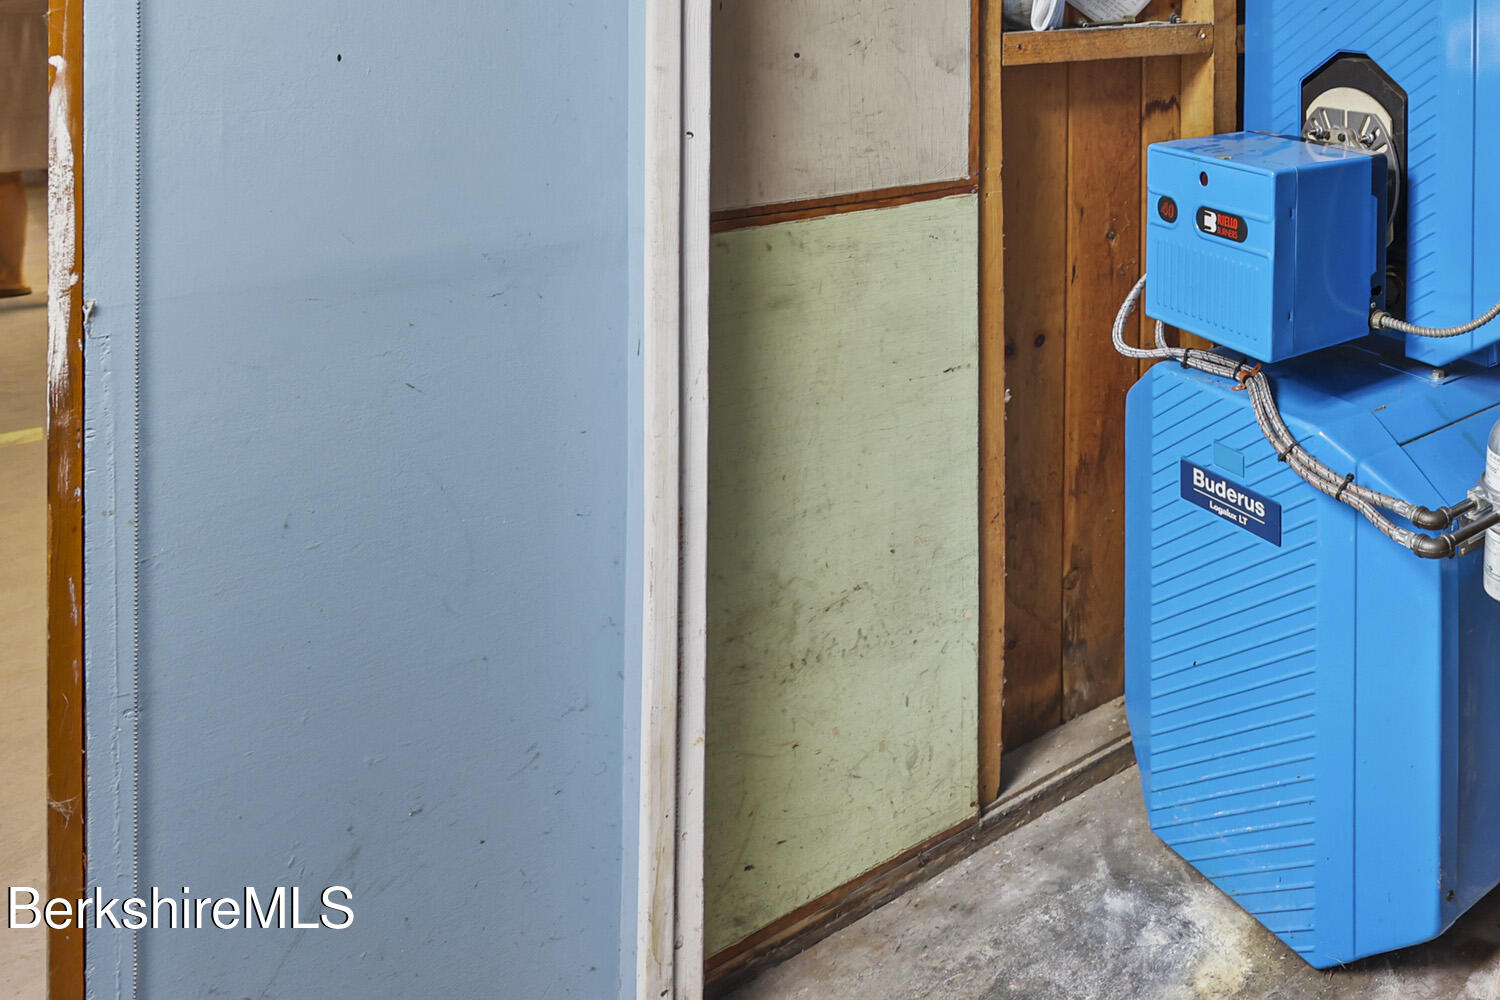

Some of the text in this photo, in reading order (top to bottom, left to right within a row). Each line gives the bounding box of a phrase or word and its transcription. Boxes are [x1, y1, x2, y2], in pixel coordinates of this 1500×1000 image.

[1160, 202, 1175, 219] 40
[1217, 214, 1238, 230] RIELLO
[1193, 467, 1266, 517] Buderus
[1238, 514, 1249, 526] LT
